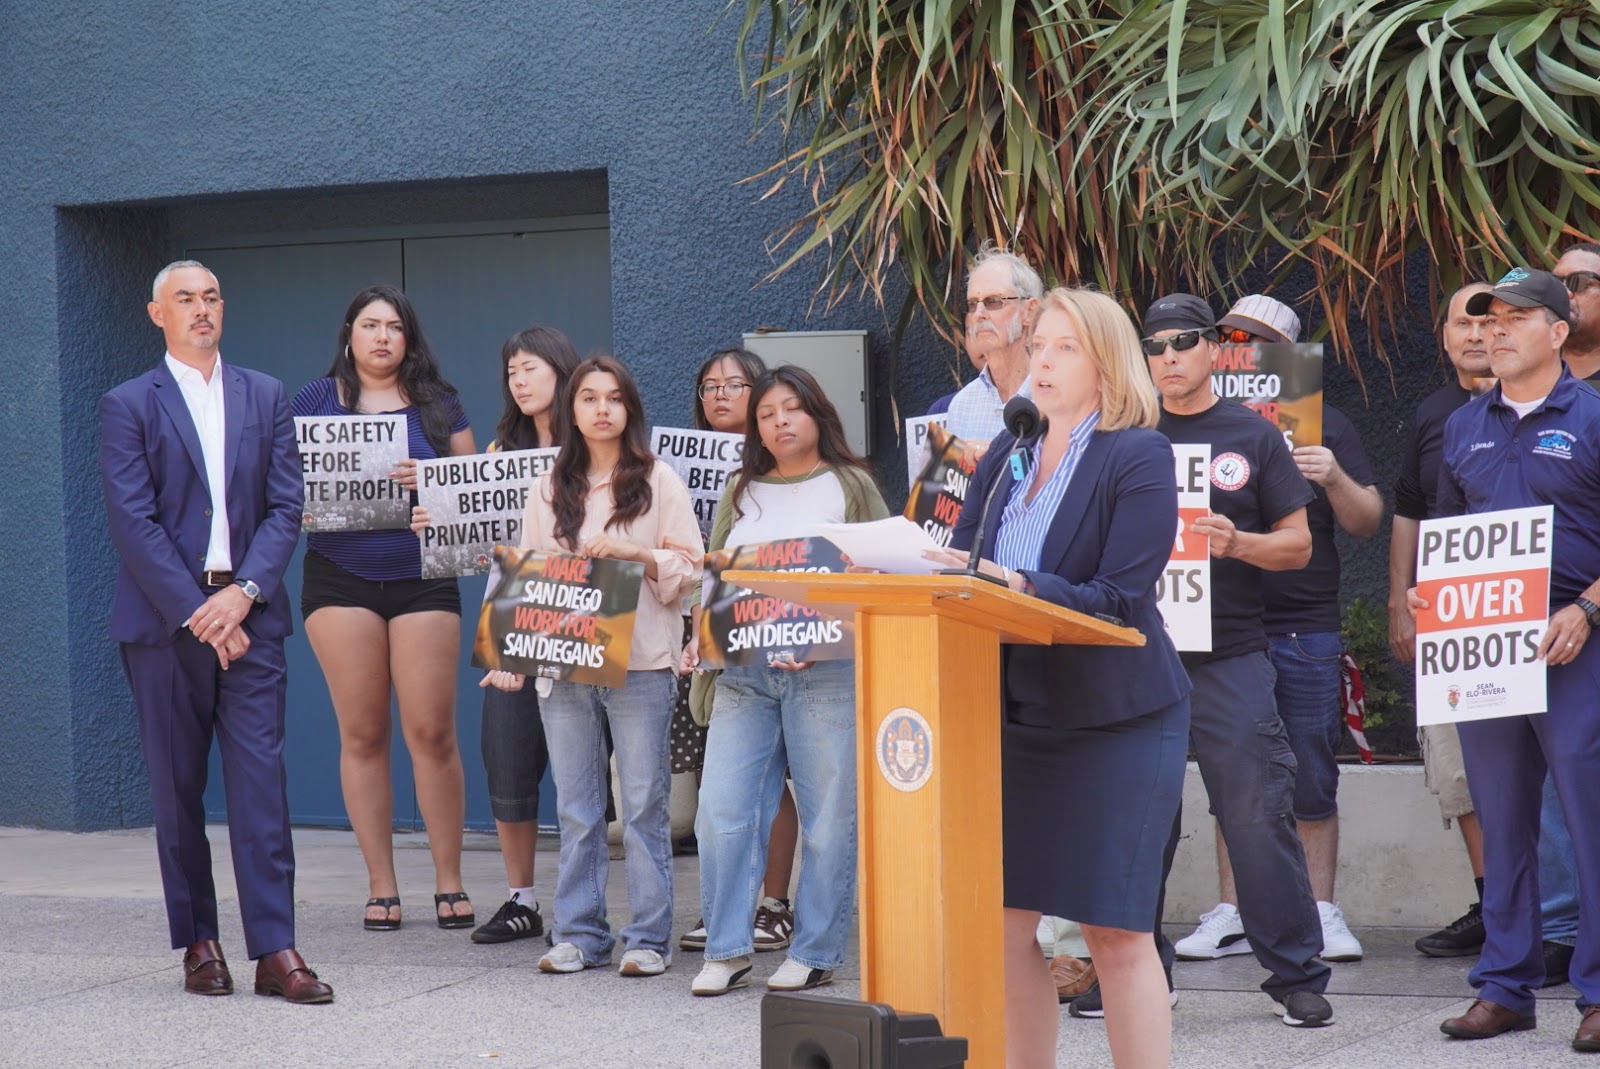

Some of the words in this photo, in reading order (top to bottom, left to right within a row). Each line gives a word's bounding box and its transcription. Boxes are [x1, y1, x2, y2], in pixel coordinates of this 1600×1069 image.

[1225, 374, 1281, 398] DIEGO
[1242, 402, 1279, 425] OR
[325, 421, 396, 444] SAFETY
[658, 433, 730, 462] PUBLIC
[300, 451, 361, 473] EFORE
[425, 460, 490, 488] PUBLIC
[688, 467, 730, 491] BEF
[943, 467, 968, 501] SAN
[934, 492, 963, 527] WO
[425, 520, 501, 547] PRIVATE
[1422, 518, 1547, 567] PEOPLE
[755, 541, 809, 568] MAKE
[542, 555, 590, 584] MAKE
[522, 580, 556, 607] SAN
[555, 584, 603, 612] DIEGO
[1436, 578, 1525, 623] OVER
[514, 606, 565, 635] WORK
[564, 614, 599, 639] FOR
[734, 597, 788, 625] WORK
[503, 632, 537, 659] SAN
[535, 637, 605, 668] DIEGANS
[727, 623, 763, 652] SAN
[761, 620, 843, 647] DIEGANS
[1421, 629, 1540, 676] ROBOTS
[1466, 687, 1507, 698] ELO-RIVERA
[1476, 682, 1495, 691] SEAN
